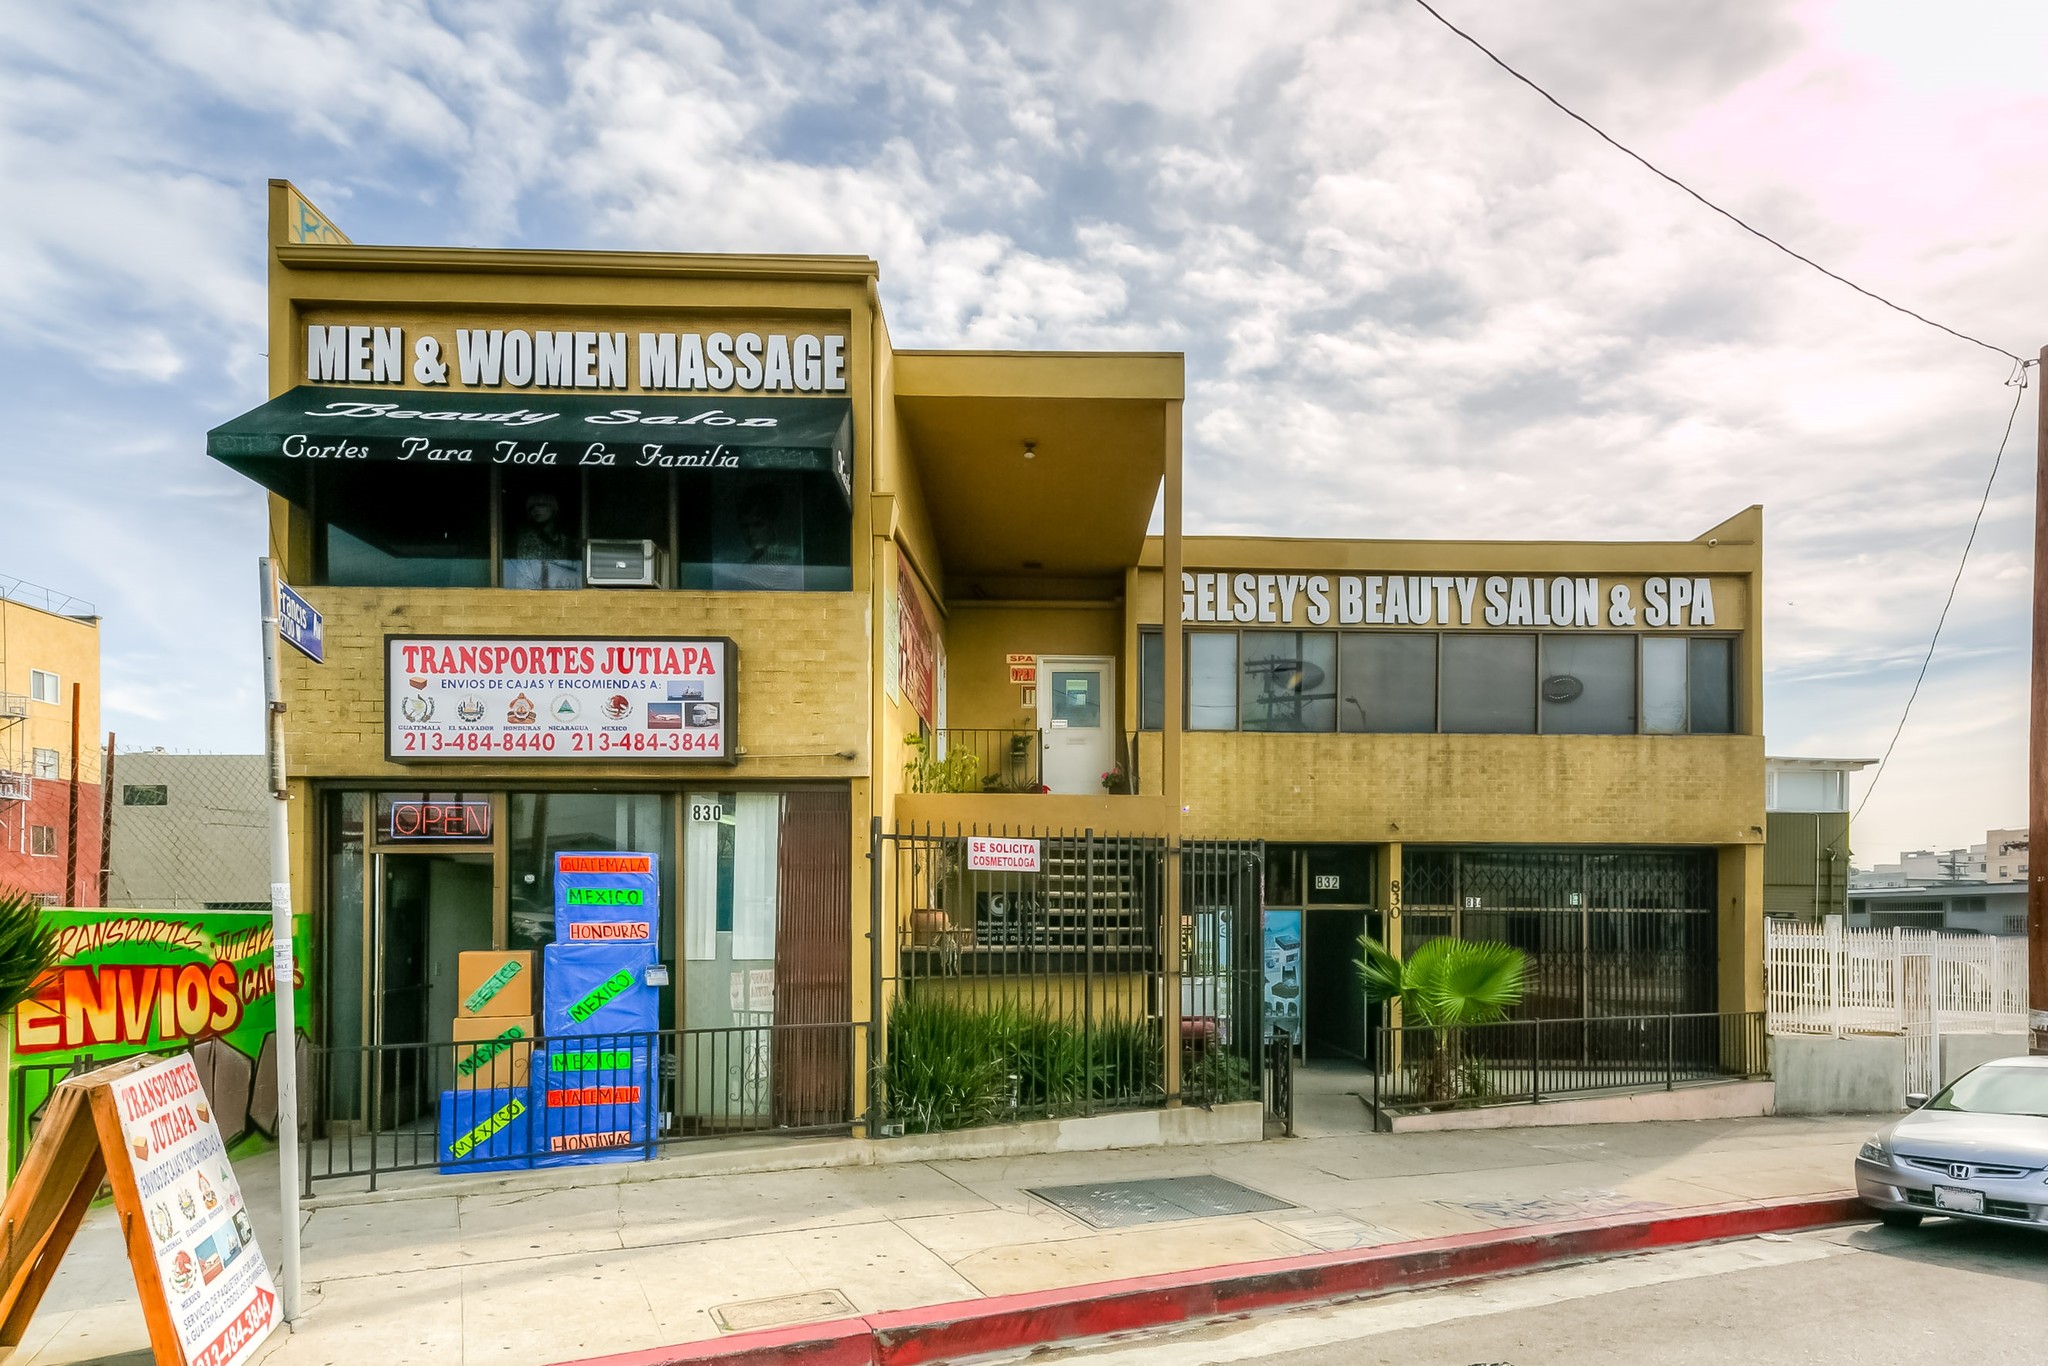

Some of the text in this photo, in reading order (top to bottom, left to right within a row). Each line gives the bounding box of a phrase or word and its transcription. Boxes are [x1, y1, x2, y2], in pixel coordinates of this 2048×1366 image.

[308, 325, 845, 391] MEN & WOMEN MASSAGE
[304, 402, 778, 427] Beauty Salon
[282, 434, 369, 458] Cortes
[397, 437, 473, 461] Para
[492, 441, 557, 465] Toda
[579, 443, 615, 465] La
[635, 444, 739, 468] Familia
[1182, 573, 1715, 627] GELSEY'S BEAUTY SALON & SPA
[402, 645, 716, 675] TRANSPORTES JUTIAPA
[1012, 668, 1036, 681] OPEN
[441, 679, 662, 690] ENVIOS DE CAJAS Y ENCOMIENDAS A:
[403, 732, 720, 751] 213-484-8440 213-484-3844
[395, 804, 488, 836] OPEN
[692, 804, 722, 821] 830
[973, 841, 1036, 855] SE SOLICITA
[973, 855, 1036, 868] COSMETOLOGA
[560, 857, 647, 872] GUATEMALA
[569, 889, 639, 904] MEXICO
[1316, 876, 1338, 889] 832
[1391, 880, 1401, 919] 830
[57, 917, 203, 963] RANSPORTES
[571, 923, 648, 939] HONDURAS
[15, 955, 304, 1053] ENVIOS CAJS
[570, 974, 630, 1023] MEXICO
[121, 1062, 198, 1121] TRANSPORTES
[150, 1103, 197, 1154] JUTIAPA
[452, 1104, 520, 1156] MEXICO
[181, 1291, 201, 1311] MEXICO
[184, 1300, 210, 1330] SERVICIO
[209, 1293, 219, 1308] DE
[191, 1306, 224, 1341] GUATEMALA
